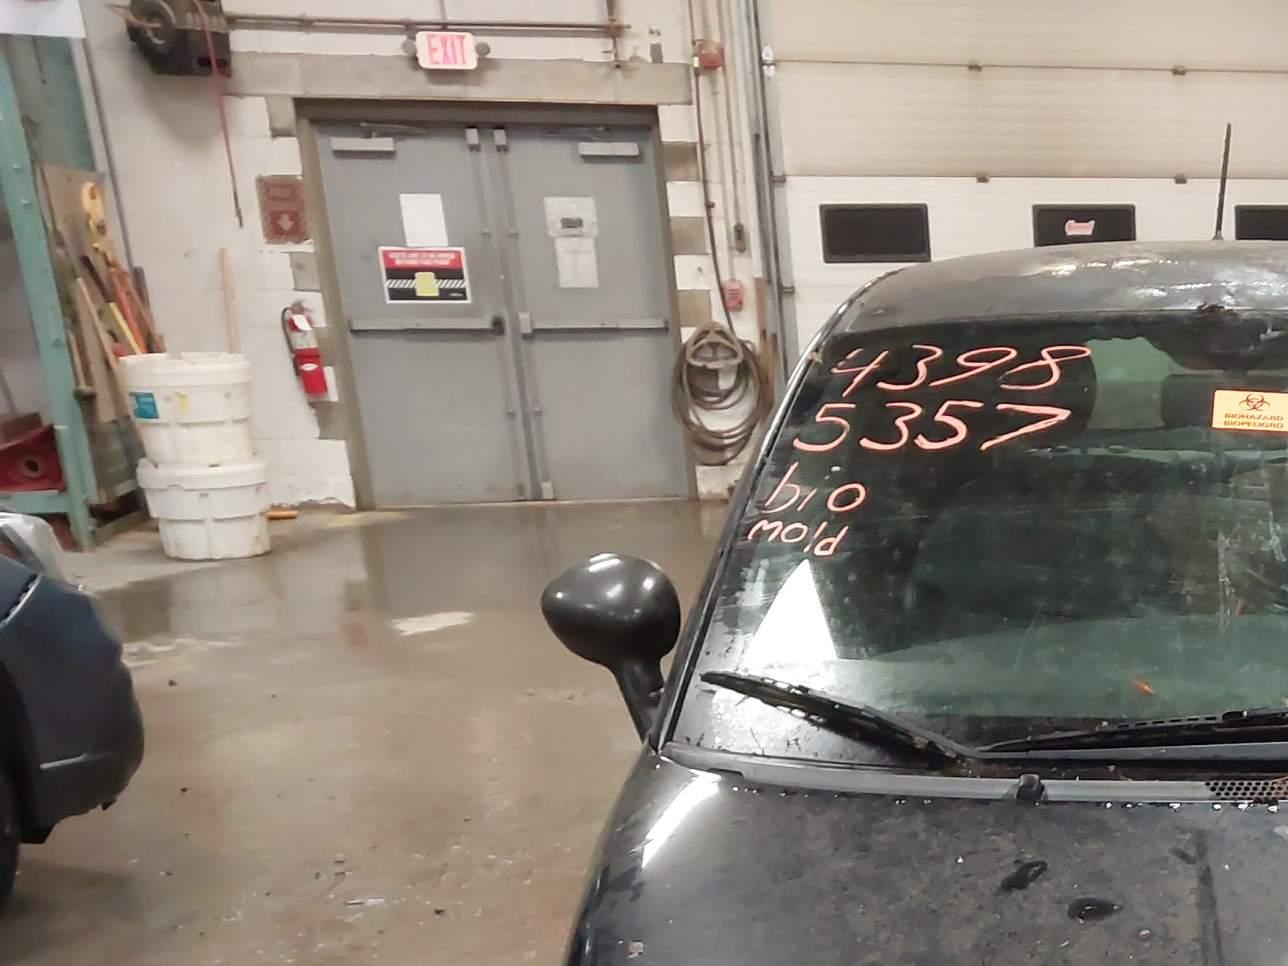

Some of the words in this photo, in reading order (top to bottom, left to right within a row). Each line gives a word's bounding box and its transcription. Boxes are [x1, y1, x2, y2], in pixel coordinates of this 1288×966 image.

[427, 33, 467, 65] EXIT
[831, 344, 1092, 398] 4398
[792, 400, 1072, 451] 5357
[1224, 412, 1284, 421] BIOHAZARD
[760, 461, 867, 513] bio
[747, 519, 849, 557] mold
